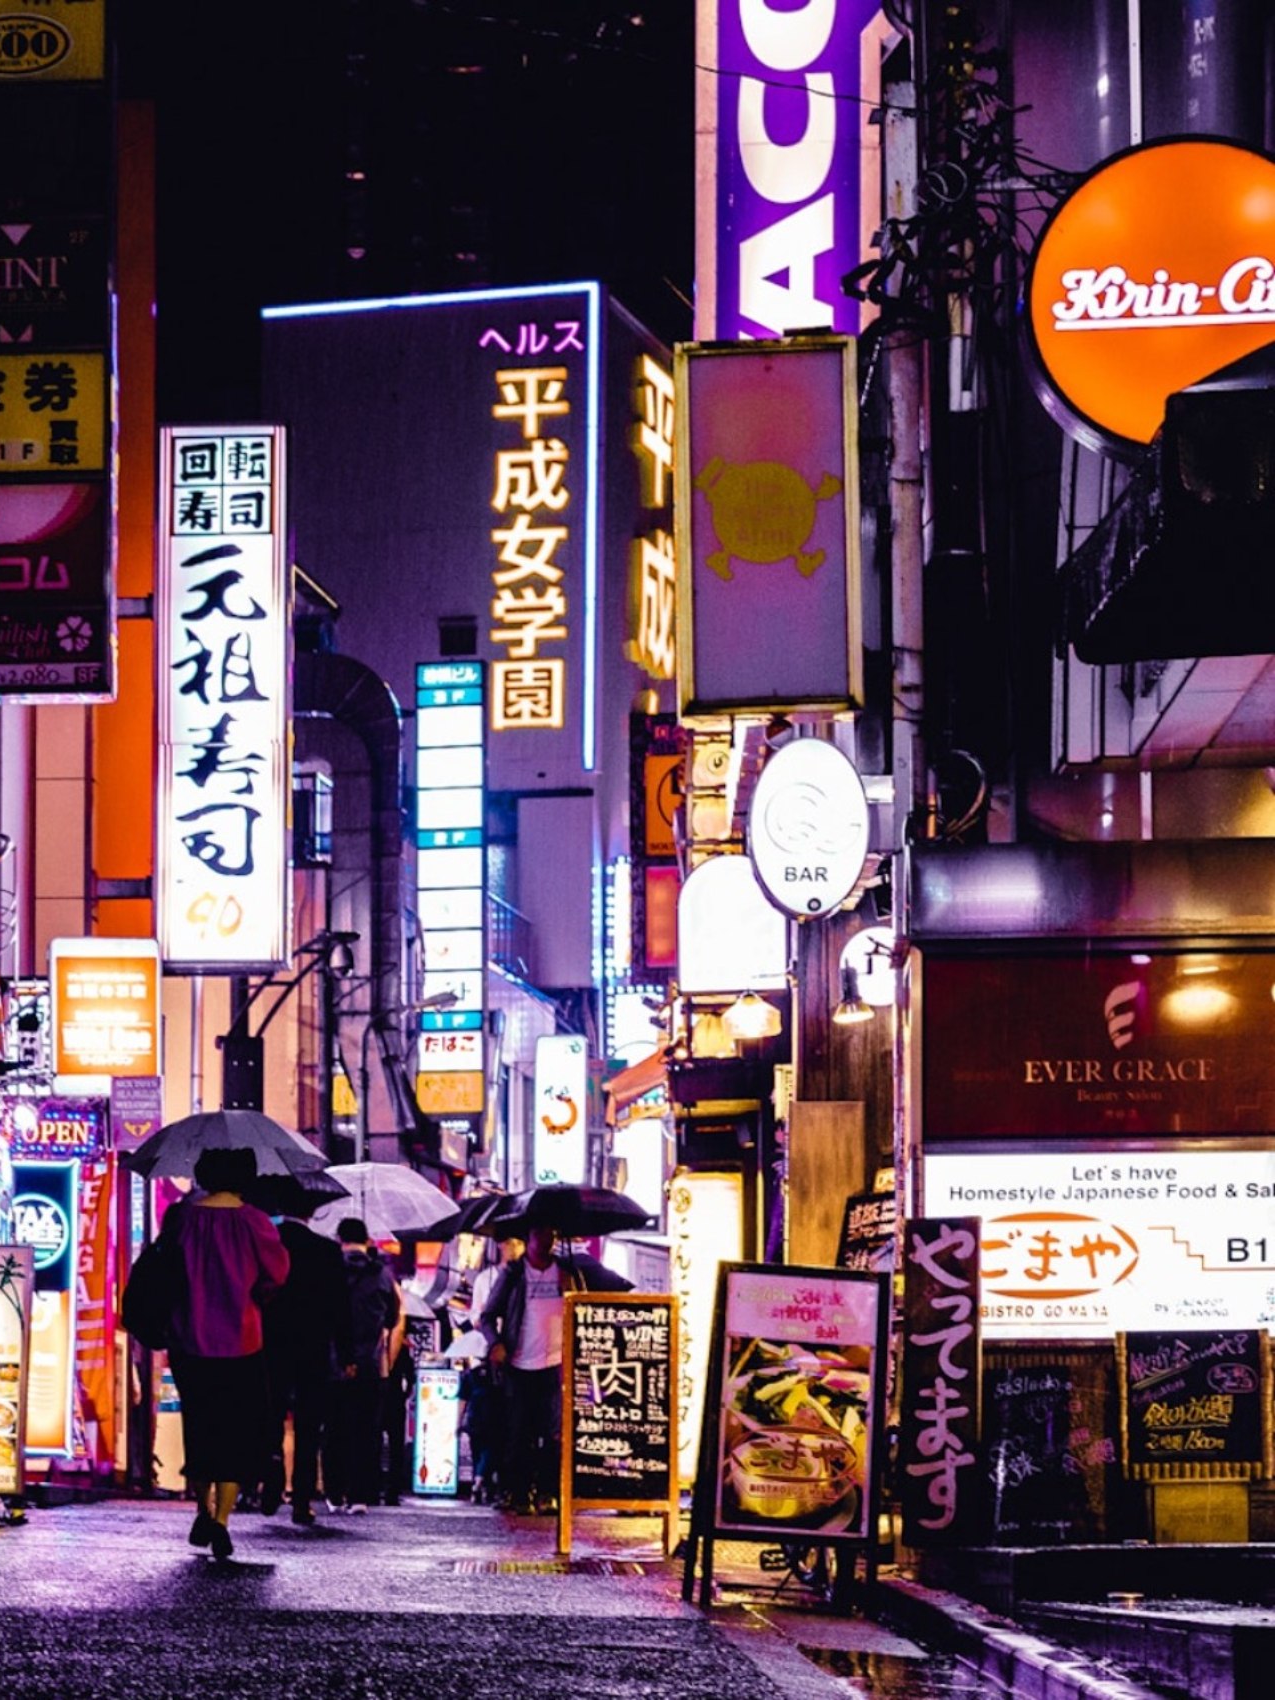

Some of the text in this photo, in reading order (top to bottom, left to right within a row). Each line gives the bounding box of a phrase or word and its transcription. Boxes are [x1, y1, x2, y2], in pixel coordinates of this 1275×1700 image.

[479, 320, 584, 355] ヘルス
[179, 441, 268, 481] 回転
[179, 490, 267, 531] 寿司
[491, 366, 570, 730] 平成女学園
[171, 544, 270, 877] 元祖寿司
[784, 866, 829, 882] BAR
[1025, 1060, 1104, 1084] EVER
[1113, 1057, 1216, 1082] GRACE
[24, 1120, 91, 1144] OPEN
[1129, 1165, 1178, 1181] have
[950, 1185, 1056, 1204] Homestyle
[1063, 1184, 1159, 1203] Japanese
[1166, 1183, 1218, 1200] Food
[1225, 1184, 1239, 1199] &
[980, 1228, 1121, 1282] ごまや
[622, 1326, 669, 1342] WINE
[590, 1347, 643, 1405] 肉
[906, 1223, 975, 1530] やってます
